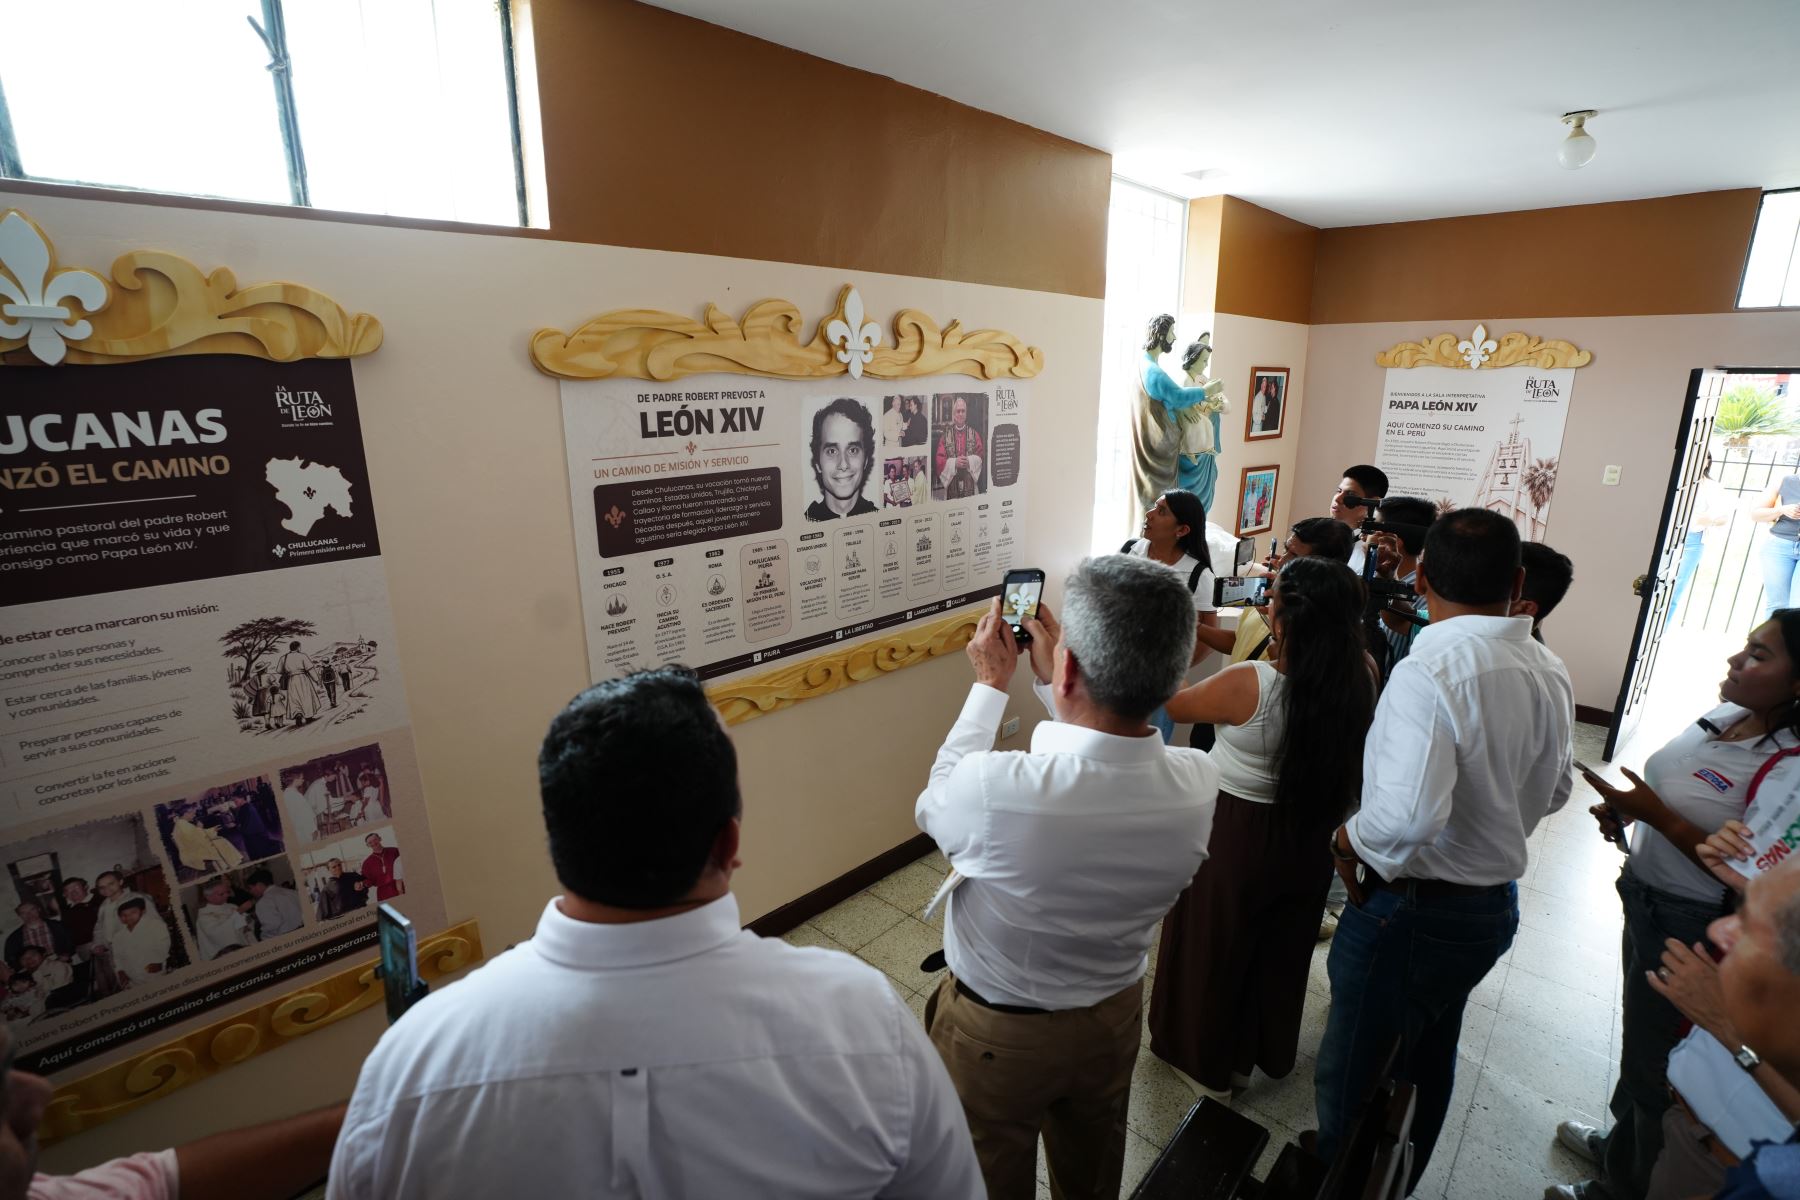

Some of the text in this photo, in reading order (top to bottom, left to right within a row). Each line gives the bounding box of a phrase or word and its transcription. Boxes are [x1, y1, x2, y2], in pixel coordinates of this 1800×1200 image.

[277, 384, 287, 392] LA
[995, 389, 1016, 402] RUTA
[1525, 379, 1556, 389] RUTA
[275, 390, 325, 408] RUTA
[637, 389, 766, 403] DE PADRE ROBERT PREVOST A
[1389, 399, 1478, 412] PAPA LEÓN XIV
[280, 403, 333, 422] DE LEÓN
[640, 404, 765, 439] LEÓN XIV
[1386, 421, 1404, 429] AQUÍ
[1442, 423, 1453, 431] SU
[1454, 424, 1485, 432] CAMINO
[66, 463, 108, 486] EL
[112, 455, 231, 482] CAMINO
[594, 467, 609, 479] UN
[612, 463, 651, 477] CAMINO
[654, 462, 666, 473] DE
[703, 458, 710, 468] Y
[711, 455, 750, 467] SERVICIO
[631, 487, 653, 497] Desde
[655, 484, 695, 495] Chulucanas,
[704, 478, 733, 488] vocación
[733, 476, 751, 485] tomó
[751, 475, 772, 483] nuevos
[632, 496, 664, 506] caminos,
[664, 492, 690, 503] Estados
[691, 490, 714, 500] Unidos,
[632, 506, 656, 516] Callao
[661, 502, 682, 512] Roma
[682, 499, 703, 509] fueron
[704, 496, 736, 506] marcando
[56, 509, 228, 538] pastoral del padre Robert
[633, 514, 671, 526] trayectoria
[672, 512, 681, 520] de
[681, 508, 715, 519] formación,
[716, 503, 744, 515] liderazgo
[634, 510, 761, 535] Décadas aquel joven misionero
[61, 523, 231, 552] que marcó su vida y que
[288, 537, 339, 550] CHULUCANAS
[635, 521, 739, 545] agustino elegido Papa León
[56, 539, 198, 566] como Papa León XIV.
[290, 548, 315, 557] Primera
[316, 546, 336, 555] misión
[603, 581, 627, 589] CHICAGO
[15, 603, 220, 644] estar cerca marcaron su misión:
[607, 626, 632, 635] PREVOST
[657, 621, 682, 630] AGUSTINO
[658, 615, 679, 624] CAMINO
[49, 637, 136, 660] a las personas y
[73, 645, 164, 669] sus necesidades.
[763, 649, 781, 658] PIURA
[6, 665, 192, 707] Estar cerca de las familias, jóvenes
[9, 697, 100, 720] y comunidades.
[18, 709, 183, 751] Preparar personas capaces de
[23, 725, 164, 762] servir a sus comunidades.
[34, 754, 177, 795] Convertir la fe en acciones
[38, 768, 171, 806] concretas por los demás.
[24, 914, 366, 1048] padre Robert Prevost durante distintos momentos de su misión pastoral en
[38, 1046, 72, 1068] Aquí
[76, 1023, 136, 1053] comenzó
[138, 1017, 156, 1029] un
[158, 999, 204, 1021] camino
[206, 989, 221, 1002] de
[222, 970, 275, 996] cercanía,
[275, 953, 317, 976] servicio
[318, 950, 326, 961] y
